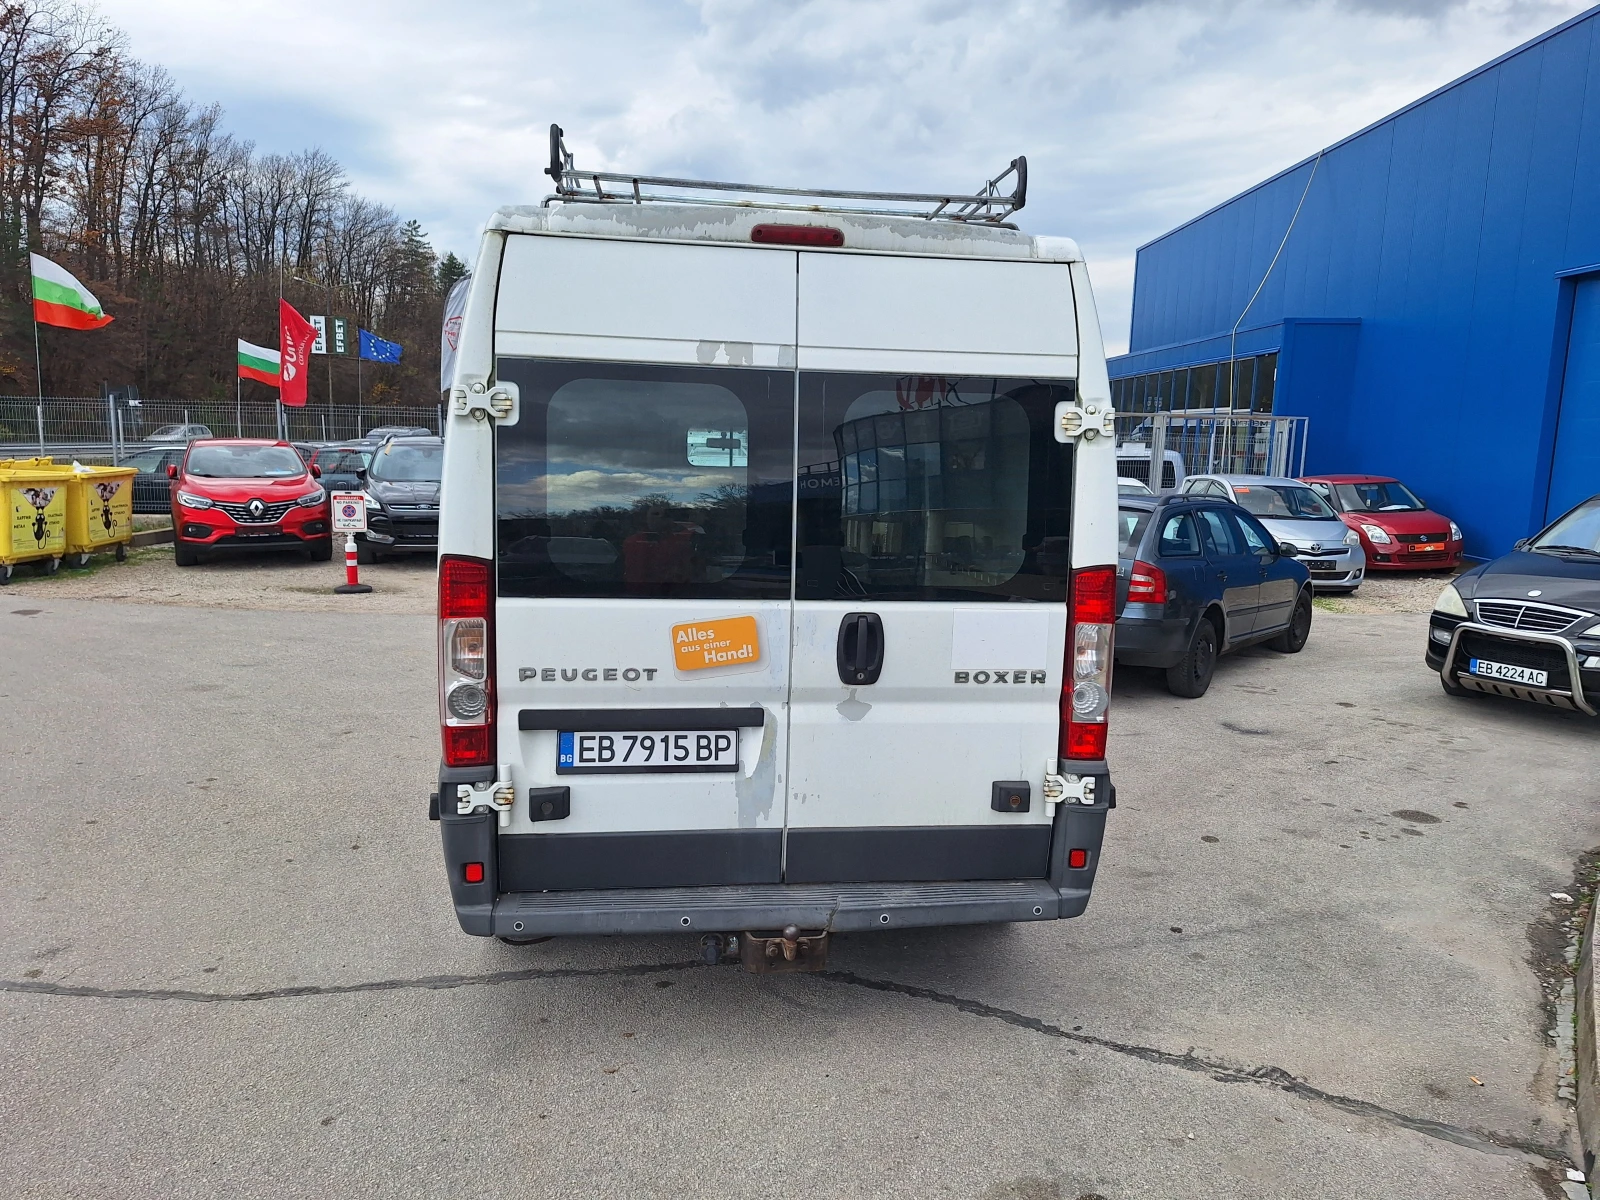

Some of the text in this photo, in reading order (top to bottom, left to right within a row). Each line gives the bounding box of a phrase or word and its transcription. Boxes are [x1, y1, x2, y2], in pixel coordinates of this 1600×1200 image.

[314, 319, 322, 351] EFBET
[335, 319, 344, 353] EFBET
[676, 627, 715, 643] Alles
[681, 640, 731, 653] aus einer
[704, 644, 754, 663] Hand!
[518, 667, 658, 682] PEUGEOT
[954, 669, 1047, 685] BOXER
[1477, 662, 1544, 684] EB 4224 AC
[578, 734, 732, 763] EB 7915 BP
[560, 754, 573, 763] BG
